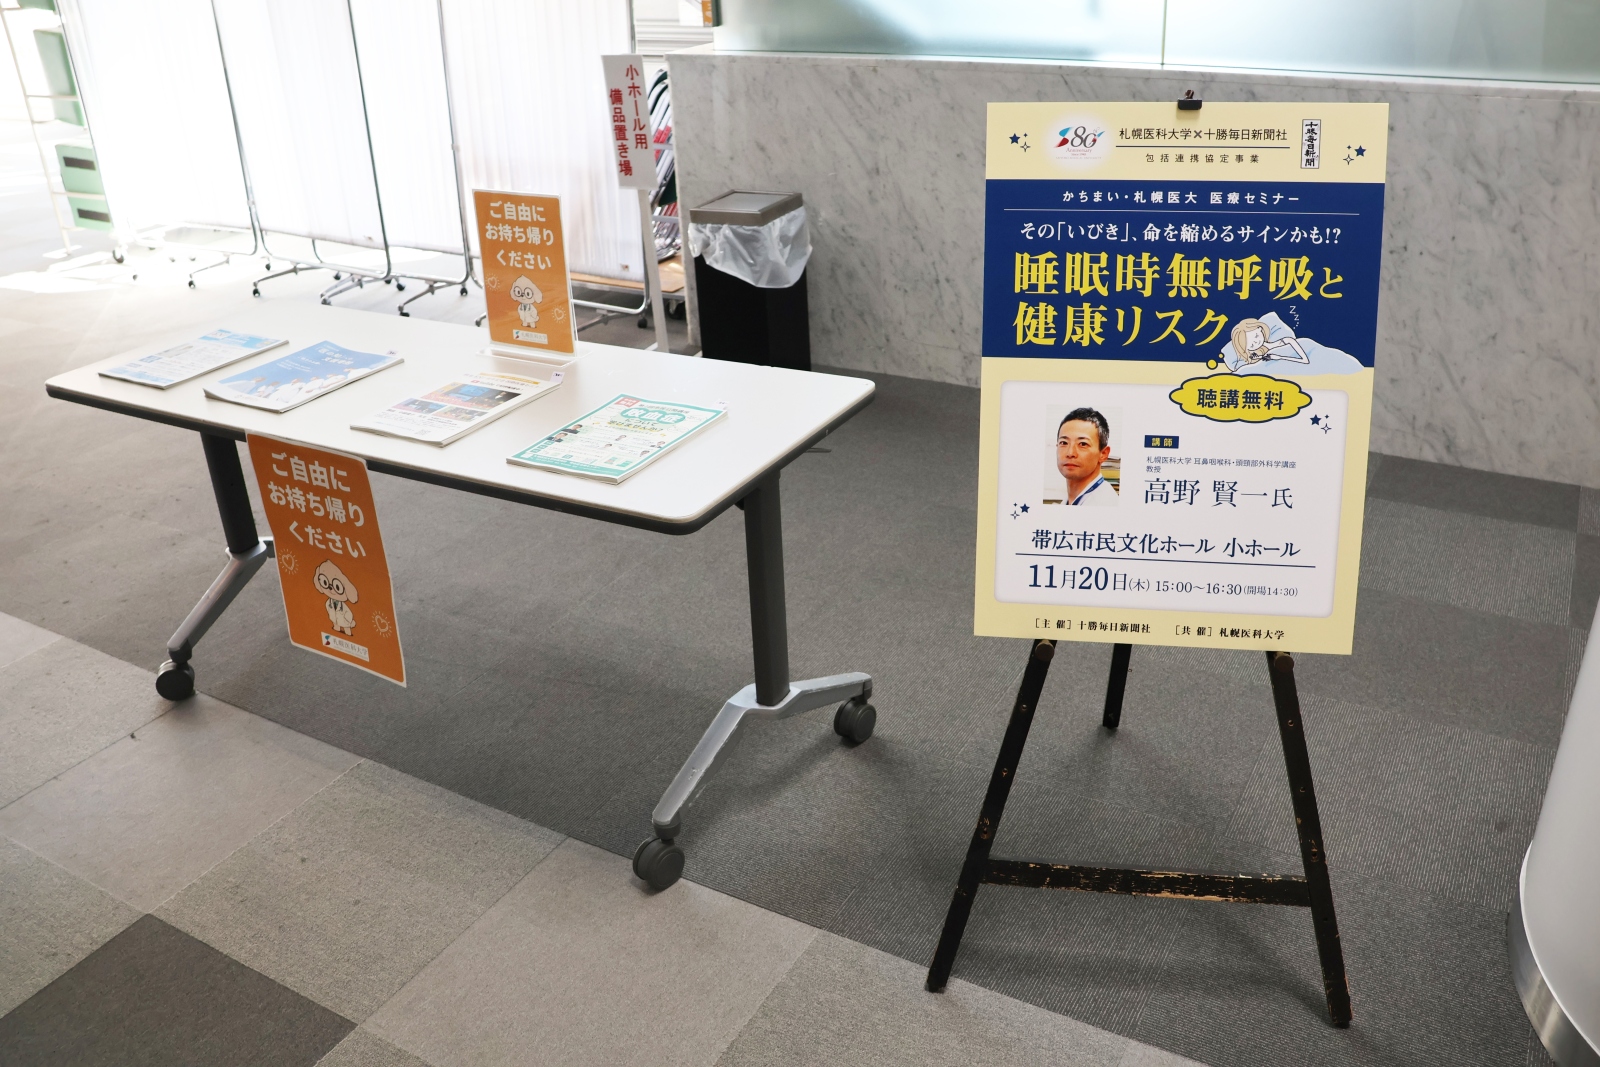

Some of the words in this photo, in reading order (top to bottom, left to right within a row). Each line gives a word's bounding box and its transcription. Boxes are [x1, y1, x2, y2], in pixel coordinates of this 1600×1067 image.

[626, 64, 648, 149] 小ホール用
[609, 88, 633, 176] 備品置き場
[1145, 153, 1260, 164] 包括連携協定事業
[1063, 190, 1198, 204] かちまい・札幌医大
[1210, 191, 1300, 205] 医療セミナー
[490, 201, 546, 222] ご自由に
[485, 223, 554, 246] お持ち帰り
[496, 249, 552, 270] ください
[1013, 250, 1344, 301] 睡眠時無呼吸と
[1012, 301, 1228, 347] 健康リスク
[1196, 388, 1285, 411] 聴講無料
[1151, 437, 1173, 447] 講師
[271, 452, 350, 492] ご自由に
[1146, 456, 1192, 465] 札幌医科大学
[268, 481, 365, 527] お持ち帰り
[1144, 477, 1201, 506] 高野
[1211, 479, 1294, 509] 賢一氏
[289, 520, 367, 559] ください
[1031, 529, 1215, 554] 帯広市民文化ホール
[1222, 537, 1302, 558] 小ホール
[1076, 621, 1151, 634] 十勝毎日新聞社
[1218, 629, 1285, 640] 札幌医科大学
